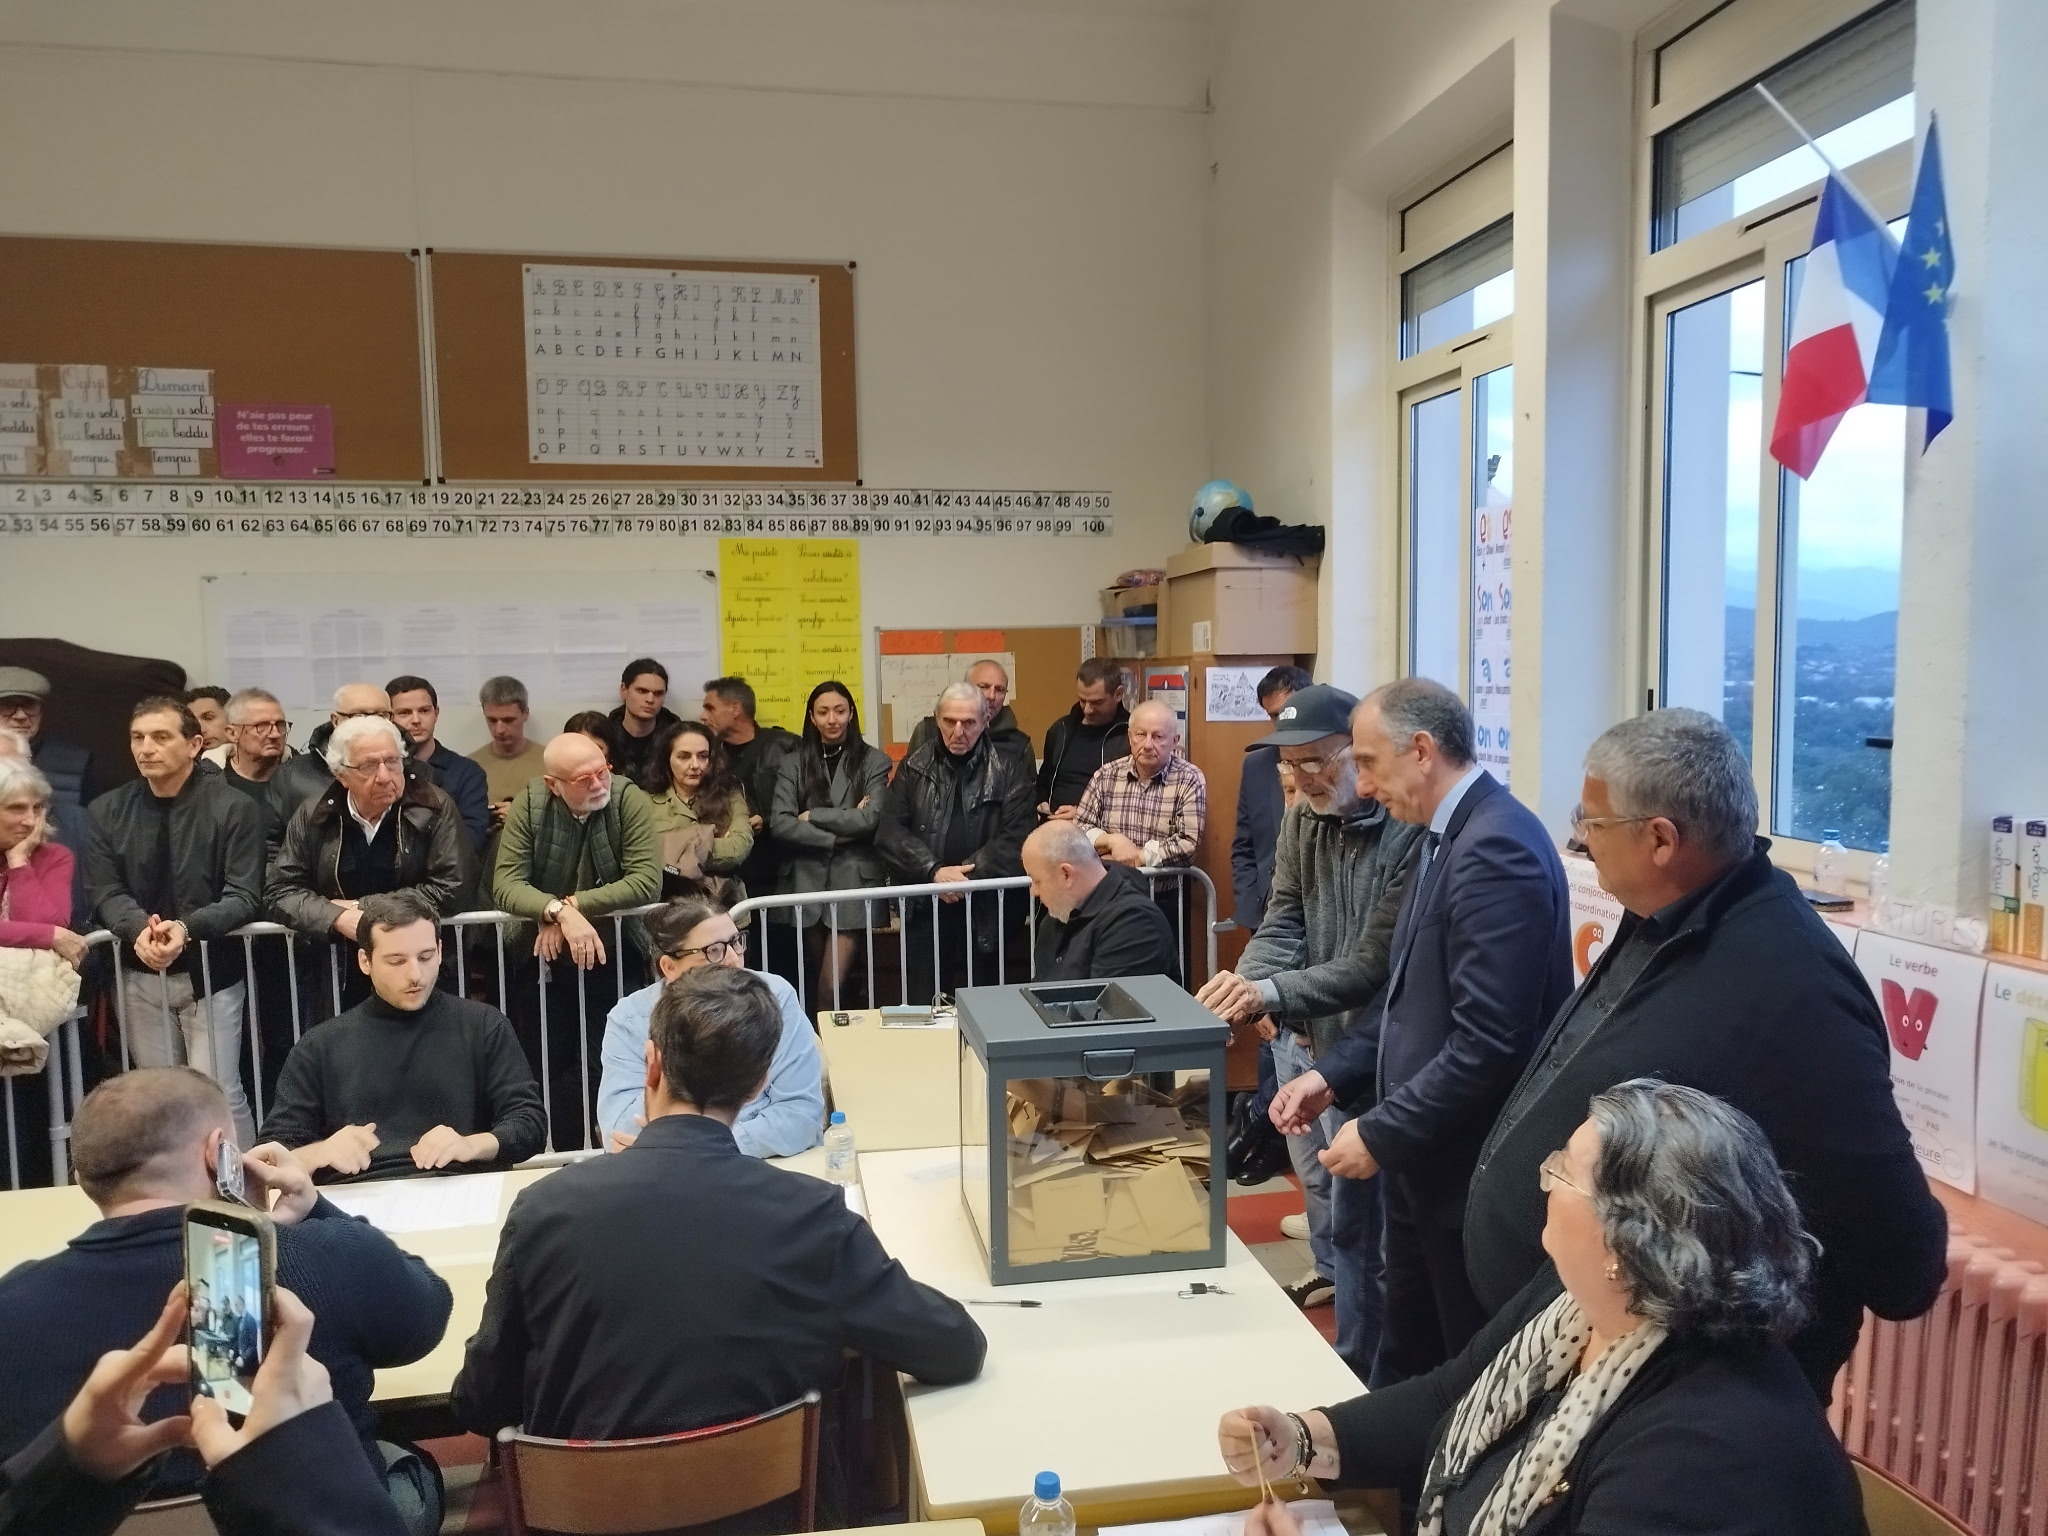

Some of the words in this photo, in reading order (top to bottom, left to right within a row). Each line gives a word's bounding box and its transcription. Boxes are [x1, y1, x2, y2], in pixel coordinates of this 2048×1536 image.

[140, 368, 205, 391] Dumani
[268, 412, 287, 421] pas
[289, 413, 313, 421] peur
[173, 418, 209, 438] beddu
[236, 421, 250, 431] de
[252, 422, 269, 431] tes
[240, 433, 265, 442] elles
[267, 434, 278, 442] te
[281, 433, 313, 442] feront
[17, 489, 26, 502] 2
[43, 489, 52, 502] 3
[68, 490, 77, 501] 4
[94, 489, 103, 502] 5
[119, 489, 128, 502] 6
[144, 490, 153, 502] 7
[170, 490, 179, 502] 8
[194, 490, 203, 503] 9
[216, 490, 233, 503] 10
[240, 490, 256, 503] 11
[265, 490, 283, 503] 12
[290, 492, 307, 504] 13
[314, 492, 331, 504] 14
[338, 492, 355, 504] 15
[362, 492, 379, 504] 16
[385, 492, 402, 505] 17
[410, 492, 426, 505] 18
[432, 493, 449, 504] 19
[455, 493, 472, 505] 20
[478, 493, 494, 505] 21
[502, 493, 519, 505] 22
[524, 493, 541, 505] 23
[548, 494, 564, 505] 24
[570, 494, 587, 505] 25
[592, 494, 609, 505] 26
[614, 494, 631, 505] 27
[637, 494, 653, 505] 28
[659, 494, 675, 506] 29
[681, 494, 697, 506] 30
[703, 494, 717, 506] 31
[725, 494, 740, 506] 32
[746, 494, 762, 506] 33
[768, 494, 784, 506] 34
[789, 494, 804, 506] 35
[811, 494, 826, 506] 36
[832, 495, 847, 506] 37
[853, 495, 868, 506] 38
[873, 495, 889, 507] 39
[894, 495, 909, 505] 40
[914, 494, 928, 506] 41
[935, 495, 950, 507] 42
[955, 496, 971, 507] 43
[975, 496, 991, 507] 44
[995, 496, 1011, 507] 45
[1016, 496, 1031, 507] 46
[1035, 496, 1050, 507] 47
[1055, 496, 1070, 508] 48
[1075, 497, 1090, 508] 49
[1096, 497, 1110, 508] 50
[14, 520, 33, 532] 53
[40, 520, 59, 532] 54
[66, 519, 85, 531] 55
[91, 519, 110, 531] 56
[116, 519, 135, 532] 57
[142, 519, 161, 531] 58
[167, 519, 186, 531] 59
[192, 519, 210, 531] 60
[217, 520, 233, 532] 61
[241, 520, 260, 532] 62
[266, 520, 285, 532] 63
[291, 520, 309, 532] 64
[315, 520, 333, 532] 65
[339, 520, 357, 532] 66
[362, 520, 380, 532] 67
[386, 521, 404, 532] 68
[410, 520, 427, 532] 69
[433, 520, 450, 532] 70
[456, 520, 472, 532] 71
[479, 520, 497, 532] 72
[502, 521, 520, 532] 73
[525, 521, 543, 532] 74
[548, 521, 565, 533] 75
[570, 520, 588, 532] 76
[593, 520, 609, 532] 77
[616, 520, 632, 532] 78
[638, 520, 654, 532] 79
[660, 520, 676, 531] 80
[682, 520, 696, 532] 81
[704, 520, 720, 531] 82
[725, 519, 741, 531] 83
[747, 520, 763, 531] 84
[769, 520, 785, 531] 85
[790, 520, 806, 531] 86
[811, 520, 827, 532] 87
[832, 520, 848, 531] 88
[853, 520, 869, 532] 89
[874, 520, 890, 531] 90
[895, 520, 909, 531] 91
[915, 520, 931, 531] 92
[936, 520, 951, 532] 93
[956, 520, 972, 531] 94
[976, 519, 992, 532] 95
[997, 520, 1012, 531] 96
[1017, 520, 1032, 531] 97
[1037, 521, 1051, 532] 98
[1056, 521, 1071, 532] 99
[1083, 521, 1105, 533] 100
[1574, 901, 1621, 922] coordination
[2027, 907, 2041, 955] LAROUSSE
[1889, 954, 1902, 968] Le
[1904, 961, 1939, 978] verbe
[1995, 983, 2012, 1001] Le
[1926, 1120, 1940, 1132] PAS
